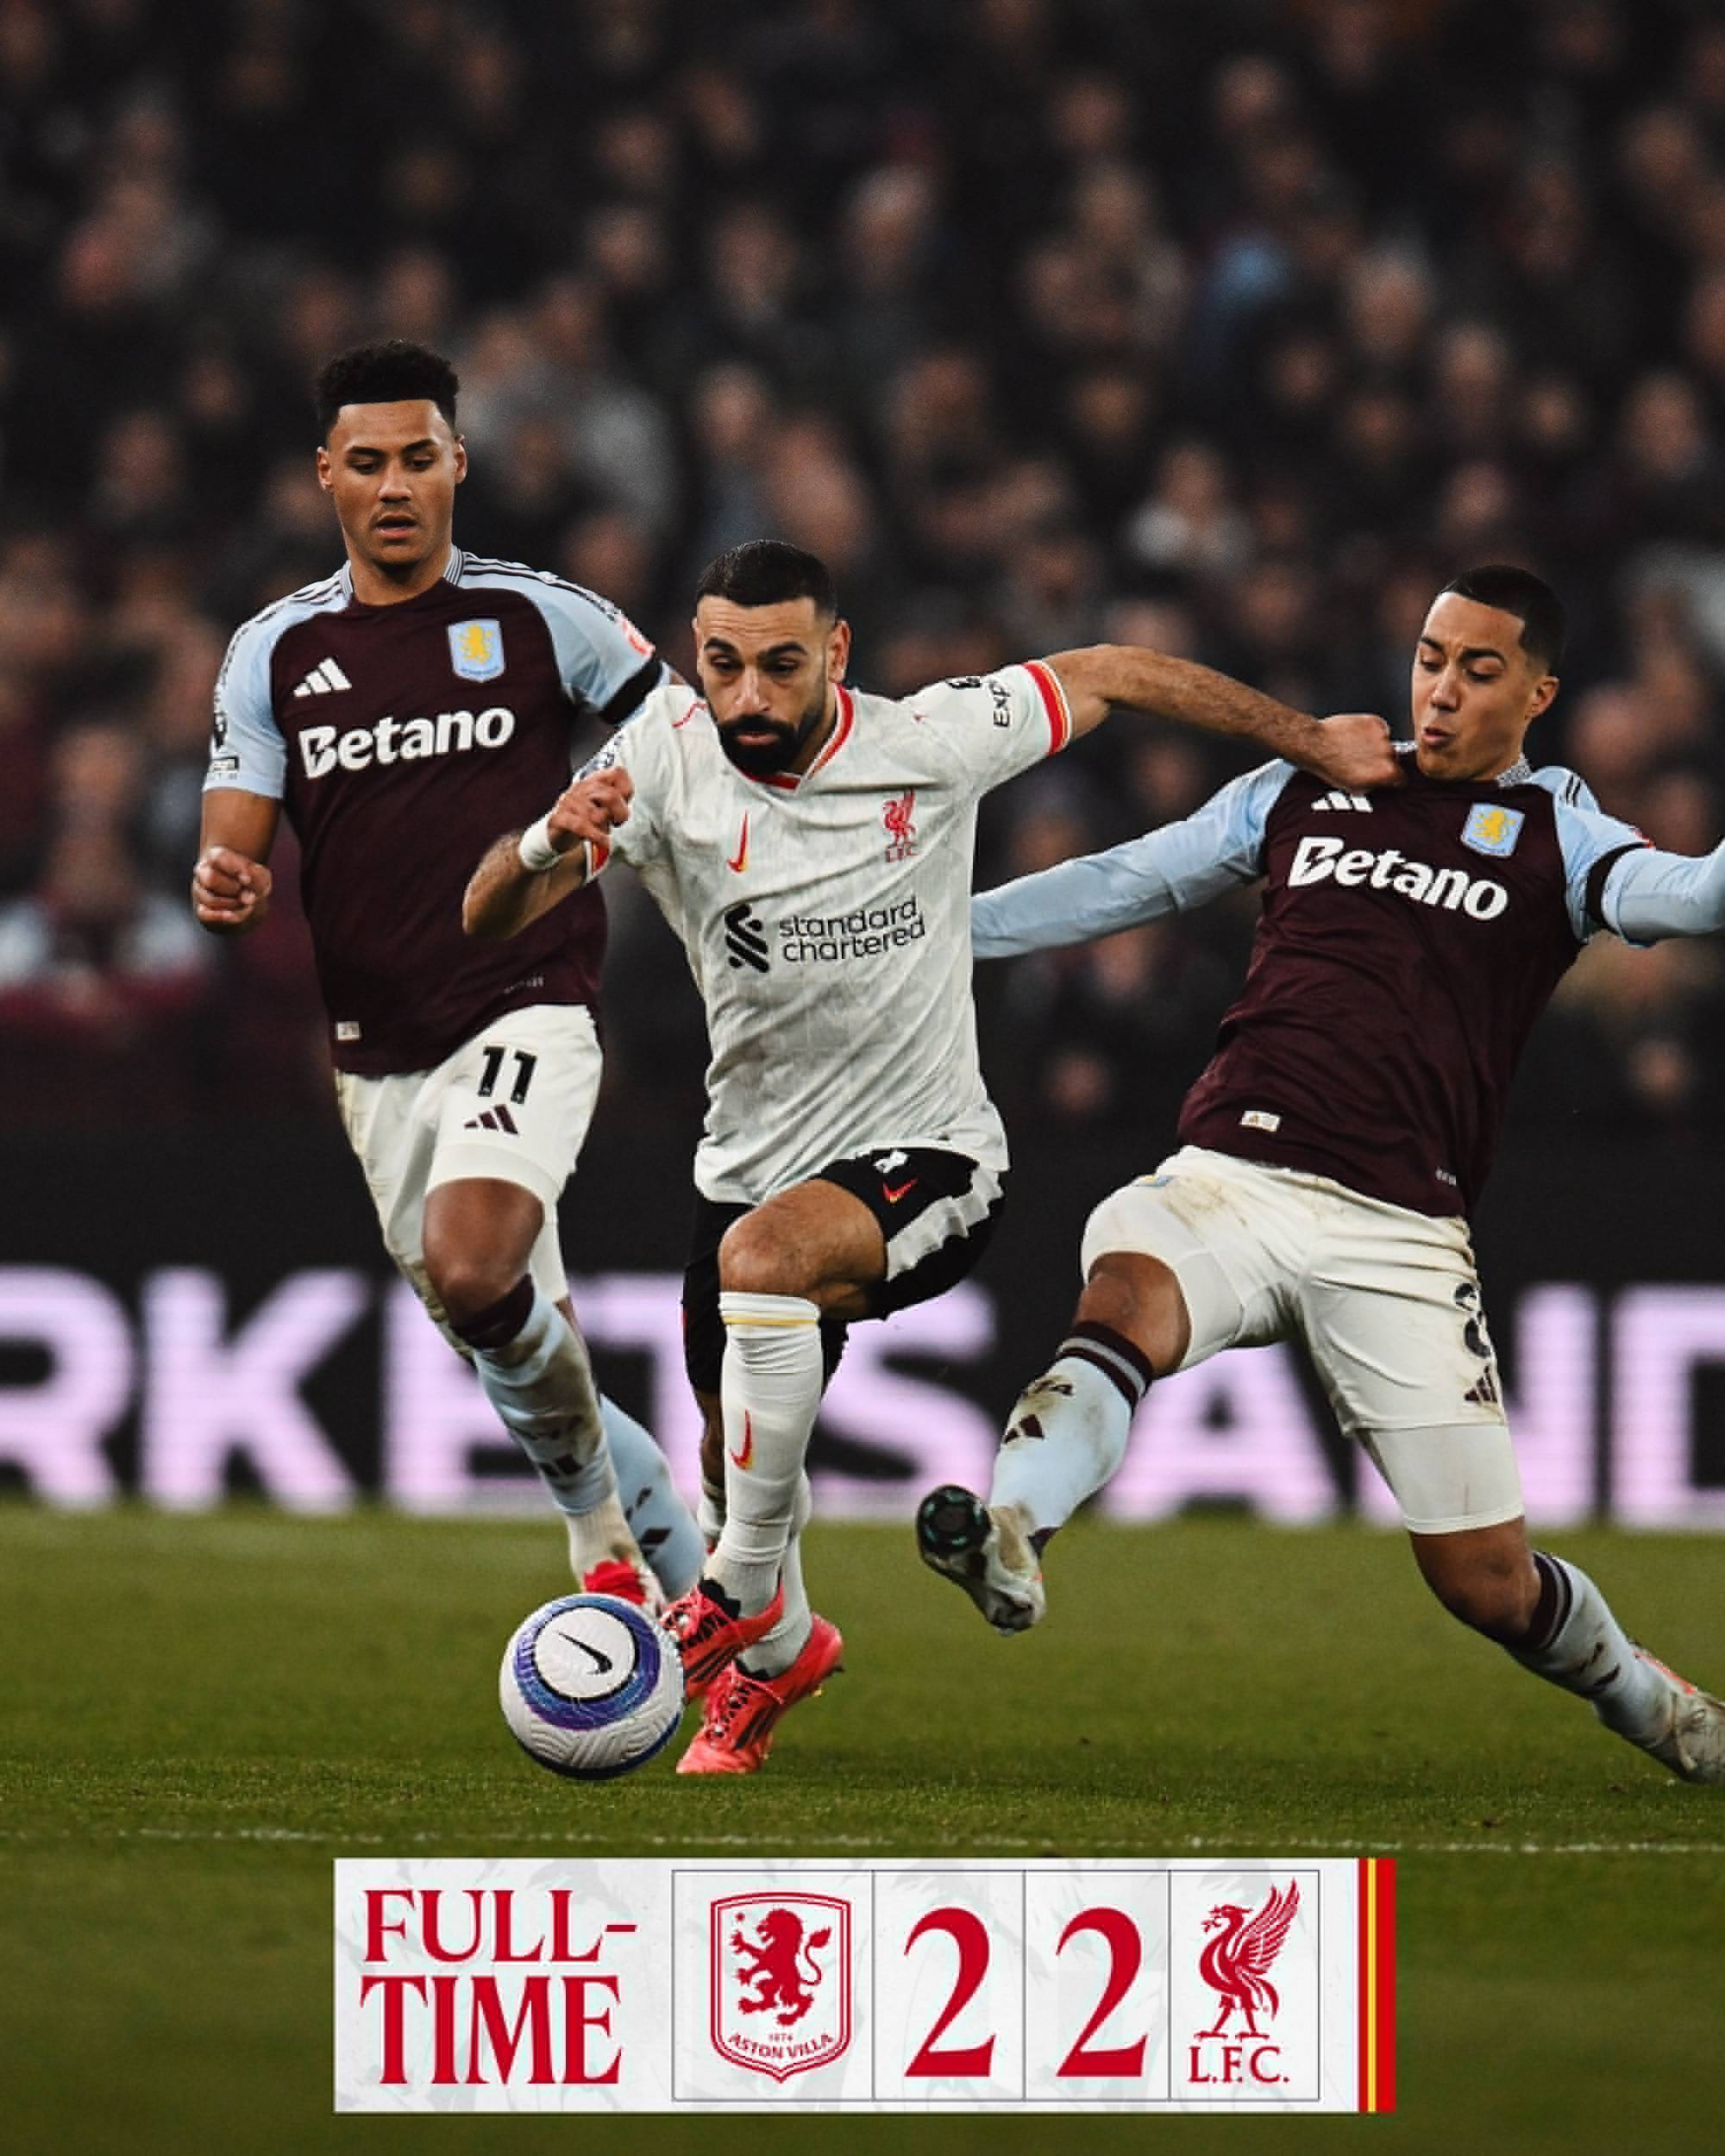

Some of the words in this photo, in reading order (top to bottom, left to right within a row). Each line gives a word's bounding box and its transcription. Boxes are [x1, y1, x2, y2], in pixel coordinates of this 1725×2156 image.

[298, 706, 516, 780] Betano
[1288, 836, 1509, 920] Betano
[779, 893, 918, 937] standard
[782, 912, 926, 962] chartered
[477, 1045, 538, 1104] 11
